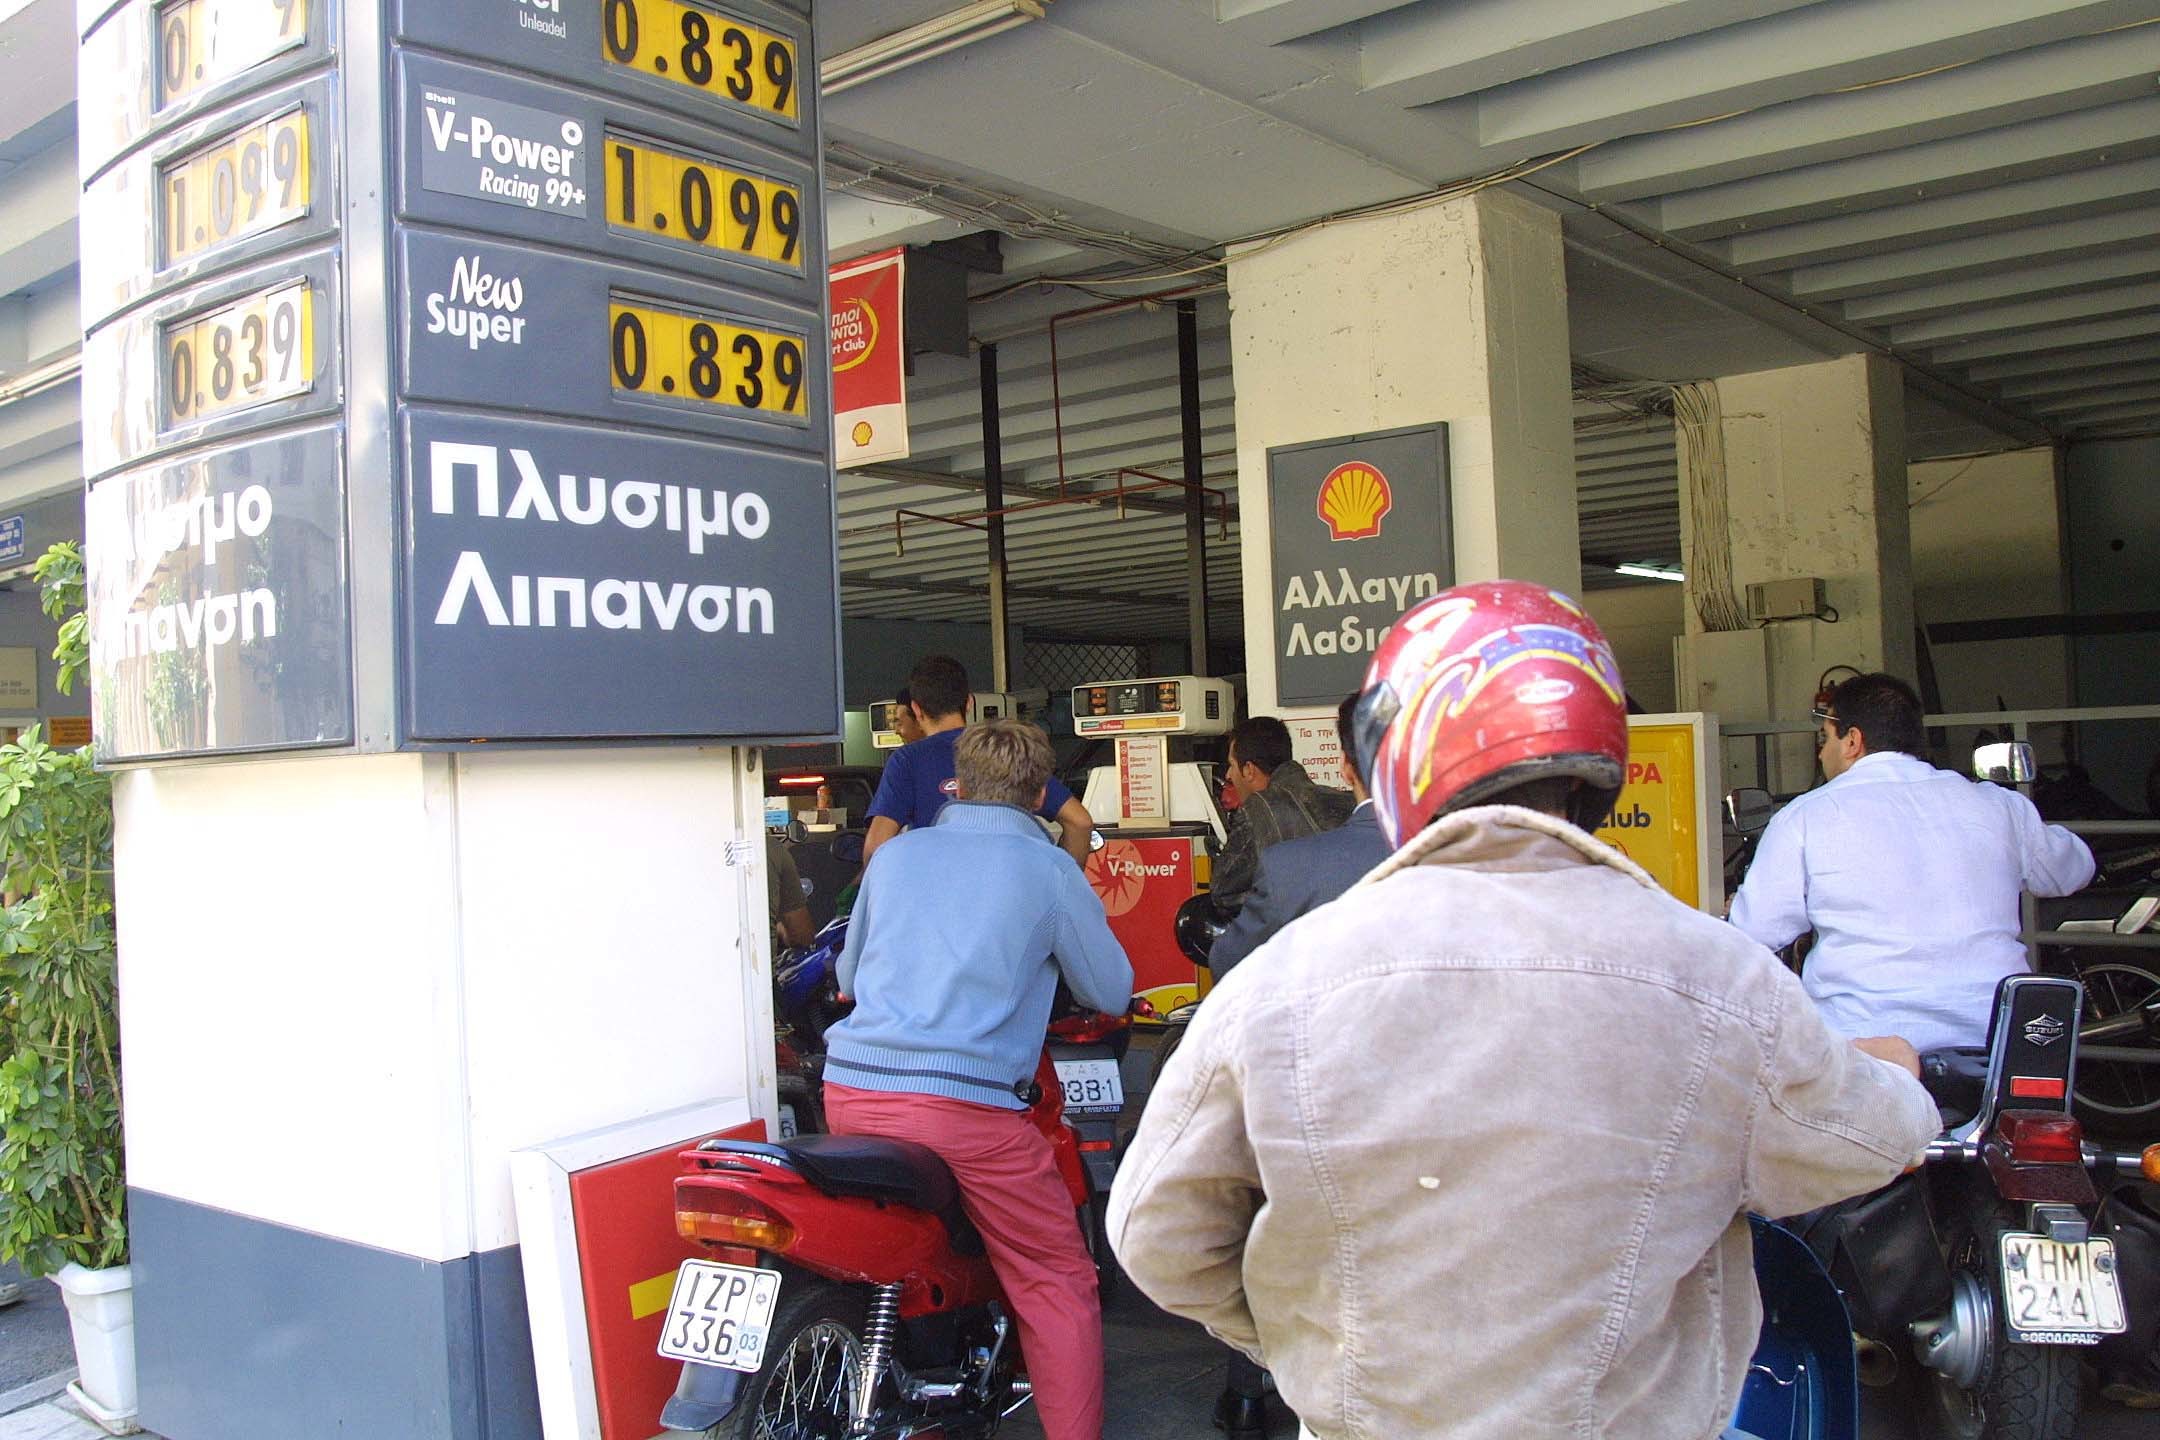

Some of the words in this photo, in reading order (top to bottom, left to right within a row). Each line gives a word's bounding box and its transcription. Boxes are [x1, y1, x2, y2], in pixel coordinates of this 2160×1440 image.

[519, 10, 567, 39] Unleaded
[605, 0, 794, 110] 0.839
[426, 106, 575, 177] V-Power
[171, 126, 297, 252] 1.099
[479, 166, 540, 208] Racing
[545, 177, 586, 207] 99+
[615, 145, 800, 261] 1.099
[449, 255, 523, 312] New
[426, 292, 526, 350] Super
[831, 321, 863, 340] ΝΤΟΙ
[842, 337, 866, 352] Club
[172, 301, 296, 417] 0.839
[613, 312, 803, 411] 0.839
[430, 441, 770, 555] Πλυσιμο
[434, 551, 775, 634] Λιπανση
[1282, 567, 1438, 612] Αλλαγη
[1600, 803, 1651, 828] lub
[1107, 860, 1177, 877] V-Power
[2018, 1284, 2089, 1322] 244
[671, 1310, 737, 1356] 336
[739, 1333, 759, 1351] 03
